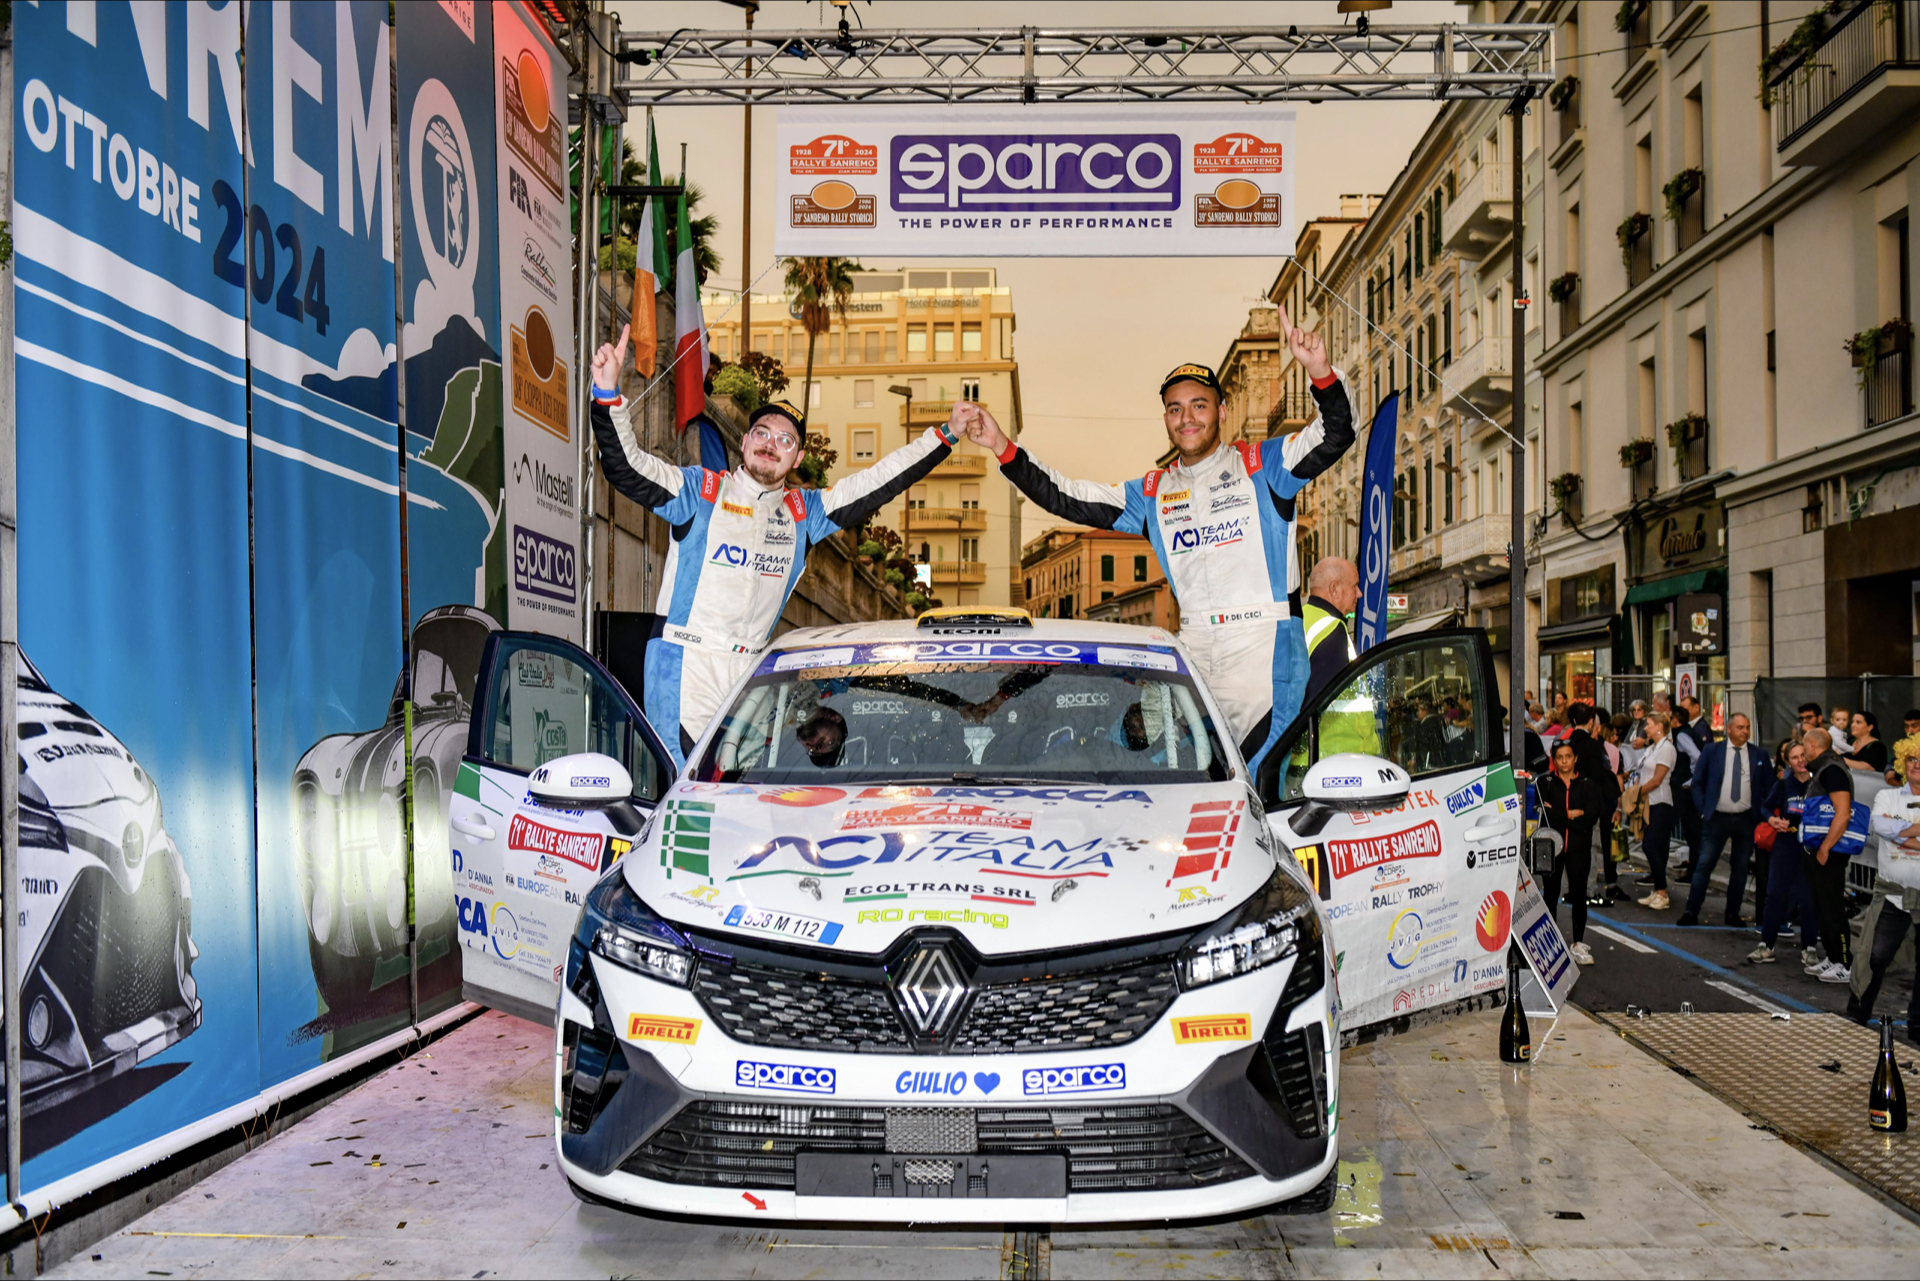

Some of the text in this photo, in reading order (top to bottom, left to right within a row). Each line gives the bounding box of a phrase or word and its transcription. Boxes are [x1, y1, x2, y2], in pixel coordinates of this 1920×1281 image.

[22, 78, 201, 243] OTTOBRE
[900, 142, 1173, 208] sparco
[803, 212, 830, 223] SANREMO
[830, 212, 849, 223] RALLY
[849, 212, 873, 223] STORICO
[899, 217, 1173, 228] THE POWER OF PERFORMANCE
[1207, 212, 1278, 223] SANREMO RALLY STORICO
[212, 179, 330, 336] 2024
[524, 379, 543, 414] COPPA
[535, 459, 574, 508] Mastelli
[1209, 478, 1242, 492] SPORT
[1163, 491, 1188, 501] PIRELLI
[1201, 518, 1239, 536] TEAM
[1201, 528, 1243, 546] ITALIA
[1172, 528, 1200, 551] ACI
[515, 532, 574, 590] sparco
[712, 543, 748, 566] ACI
[754, 553, 786, 564] TEAM
[517, 597, 526, 608] THE
[526, 598, 541, 611] POWER
[548, 603, 575, 618] PERFORMANCE
[1244, 611, 1262, 620] CECI
[674, 631, 701, 644] sparco
[871, 642, 1081, 662] sparco
[571, 777, 610, 788] sparco
[1322, 777, 1362, 788] sparco
[1446, 788, 1475, 814] GIULIO
[844, 815, 1022, 826] RALLYE SANREMO
[524, 823, 557, 852] RALLYE
[556, 833, 600, 867] SANREMO
[737, 832, 906, 870] ACI
[928, 831, 1103, 853] TEAM
[1350, 838, 1391, 869] RALLYE
[1390, 823, 1439, 858] SANREMO
[903, 846, 1114, 870] ITALIA
[1478, 845, 1517, 863] TECO
[468, 869, 494, 886] D'ANNA
[505, 875, 514, 884] FIA
[517, 876, 562, 900] EUROPEAN
[845, 881, 1036, 899] ECOLTRANS SRL
[1326, 900, 1368, 920] ROPEAN
[1372, 890, 1404, 910] RALLY
[1408, 881, 1445, 899] TROPHY
[773, 916, 790, 931] M
[794, 919, 820, 938] 112
[857, 908, 1008, 929] RO racing
[1526, 919, 1565, 982] sparco
[1473, 965, 1503, 982] D'ANNA
[631, 1017, 695, 1040] PIRELLI
[1179, 1018, 1247, 1040] PIRELLI
[738, 1063, 835, 1089] sparco
[895, 1070, 968, 1095] GIULIO
[1025, 1064, 1125, 1094] sparco
